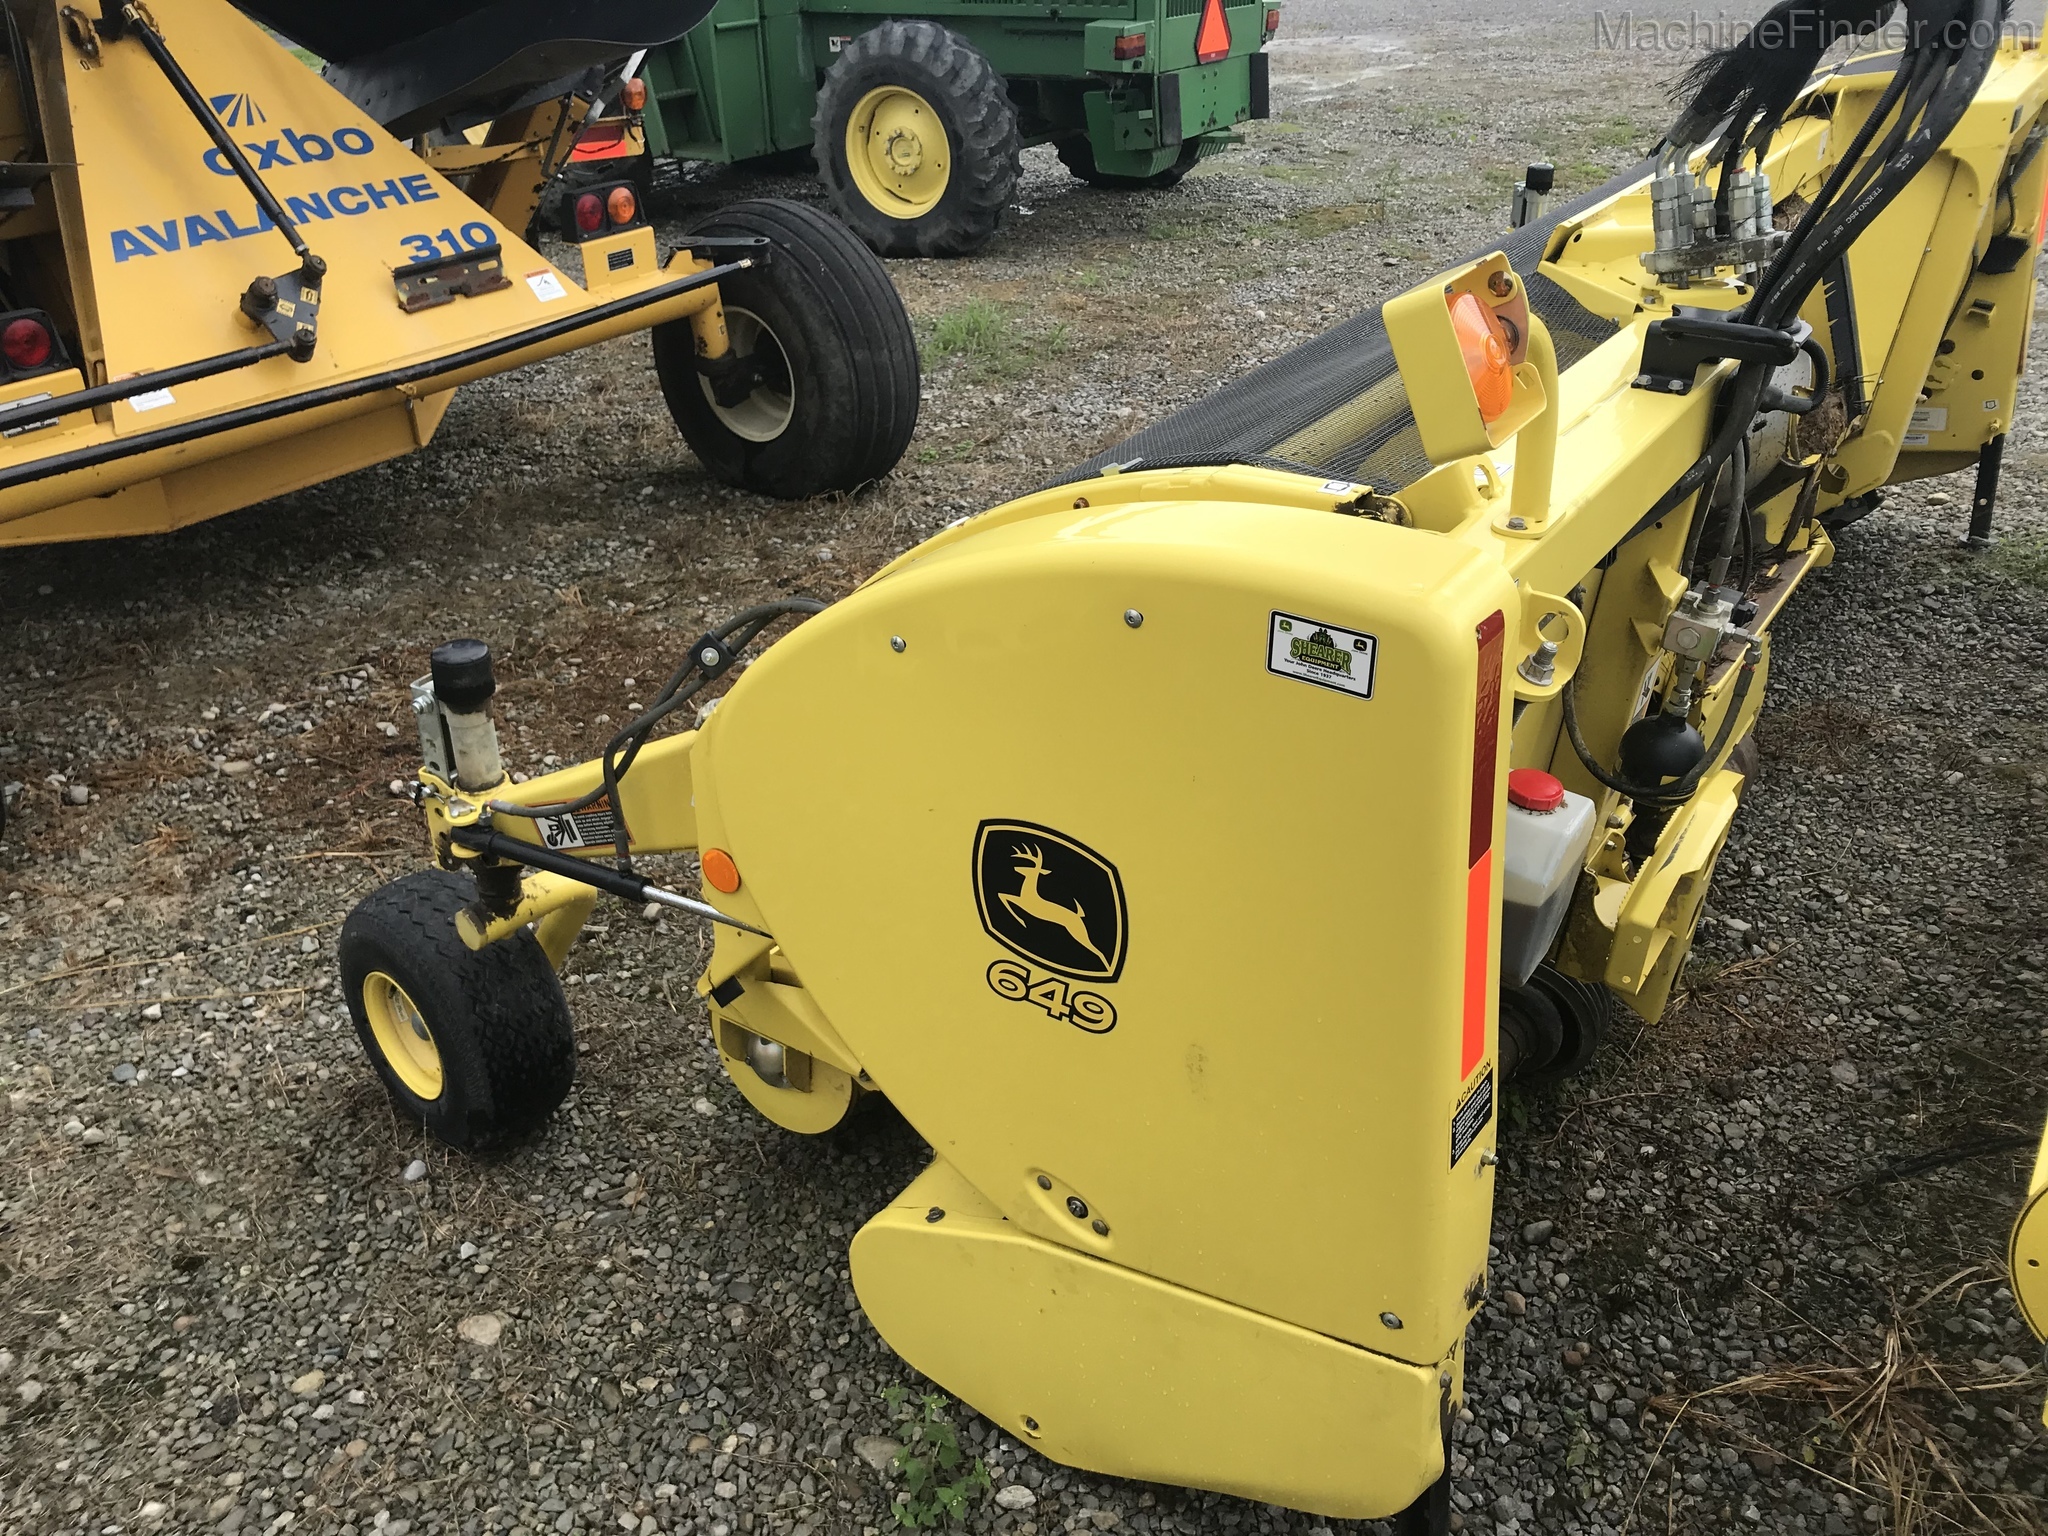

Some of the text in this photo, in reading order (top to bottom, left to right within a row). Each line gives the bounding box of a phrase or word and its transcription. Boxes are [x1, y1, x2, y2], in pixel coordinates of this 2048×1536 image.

[203, 127, 375, 176] oxbo
[110, 173, 441, 263] AVALANCHE
[399, 221, 498, 264] 310
[1290, 637, 1353, 676] SHEARER
[1301, 655, 1340, 670] EQUIPMENT
[1307, 664, 1323, 672] Deere
[985, 959, 1118, 1034] 649
[1461, 1058, 1492, 1105] CAUTION
